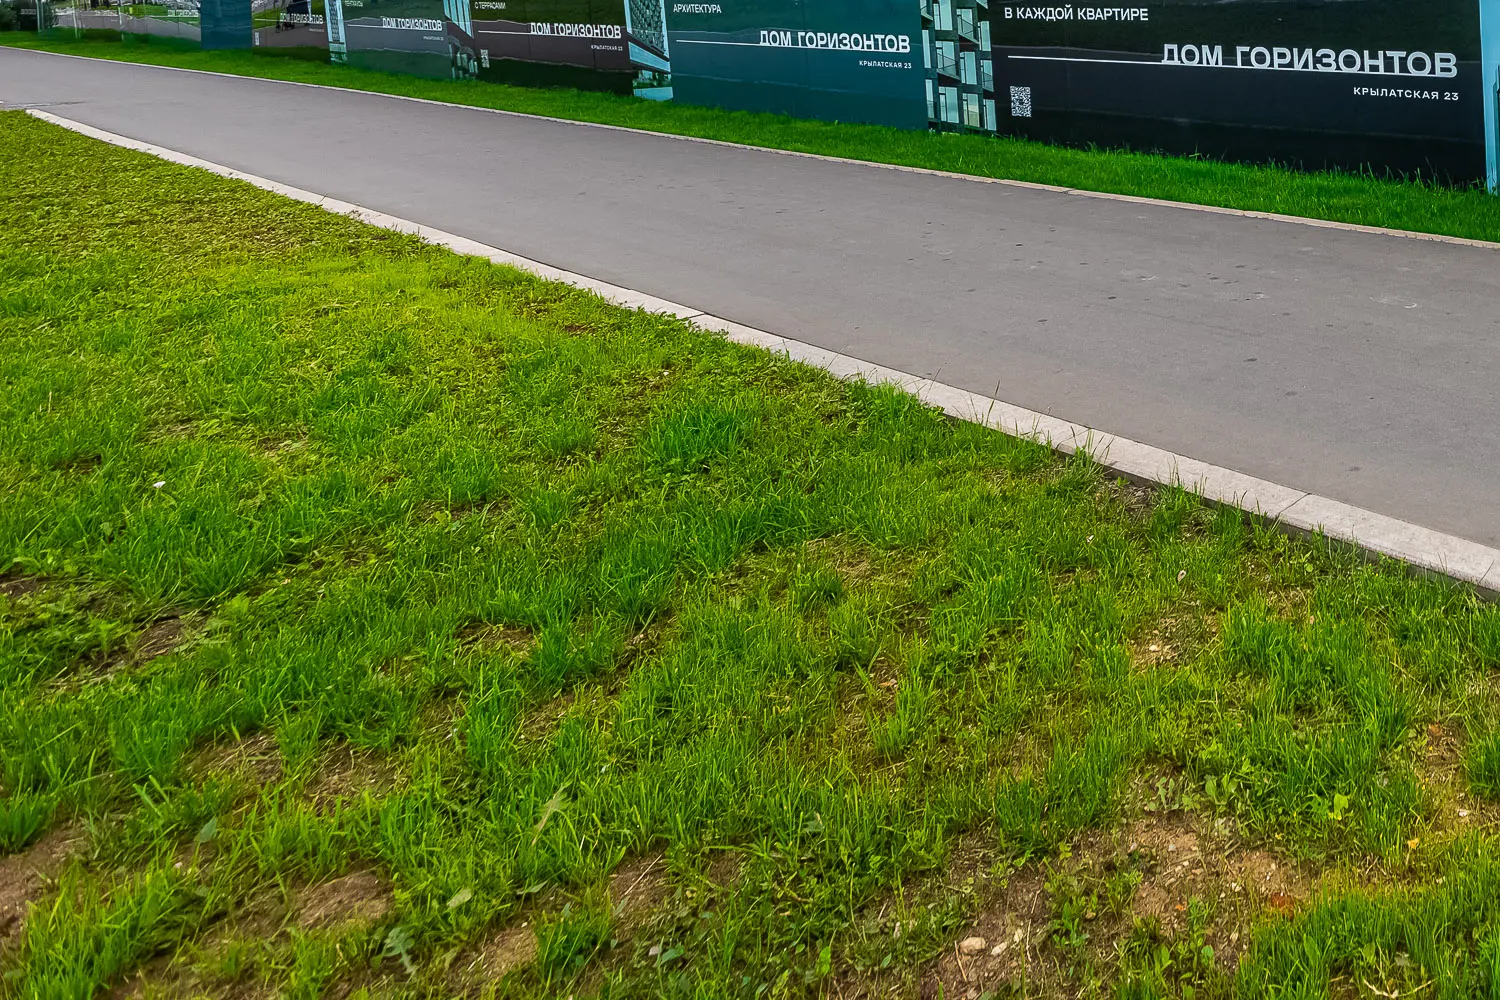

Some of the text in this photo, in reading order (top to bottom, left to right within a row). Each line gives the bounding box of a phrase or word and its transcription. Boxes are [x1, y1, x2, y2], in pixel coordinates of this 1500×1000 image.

[475, 1, 506, 10] С ТЕРРАСАМИ
[673, 3, 722, 14] АРХИТЕКТУРА
[1004, 4, 1149, 22] В КАЖДОЙ КВАРТИРЕ
[382, 17, 443, 32] ДОМ ГОРИЗОНТОВ
[530, 22, 622, 39] ДОМ ГОРИЗОНТОВ
[759, 30, 911, 53] ДОМ ГОРИЗОНТОВ
[859, 60, 912, 69] КРЫЛАТСКАЯ 23
[1161, 44, 1458, 78] ДОМ ГОРИЗОНТОВ
[1353, 86, 1459, 101] КРЫЛАТСКАЯ 23
